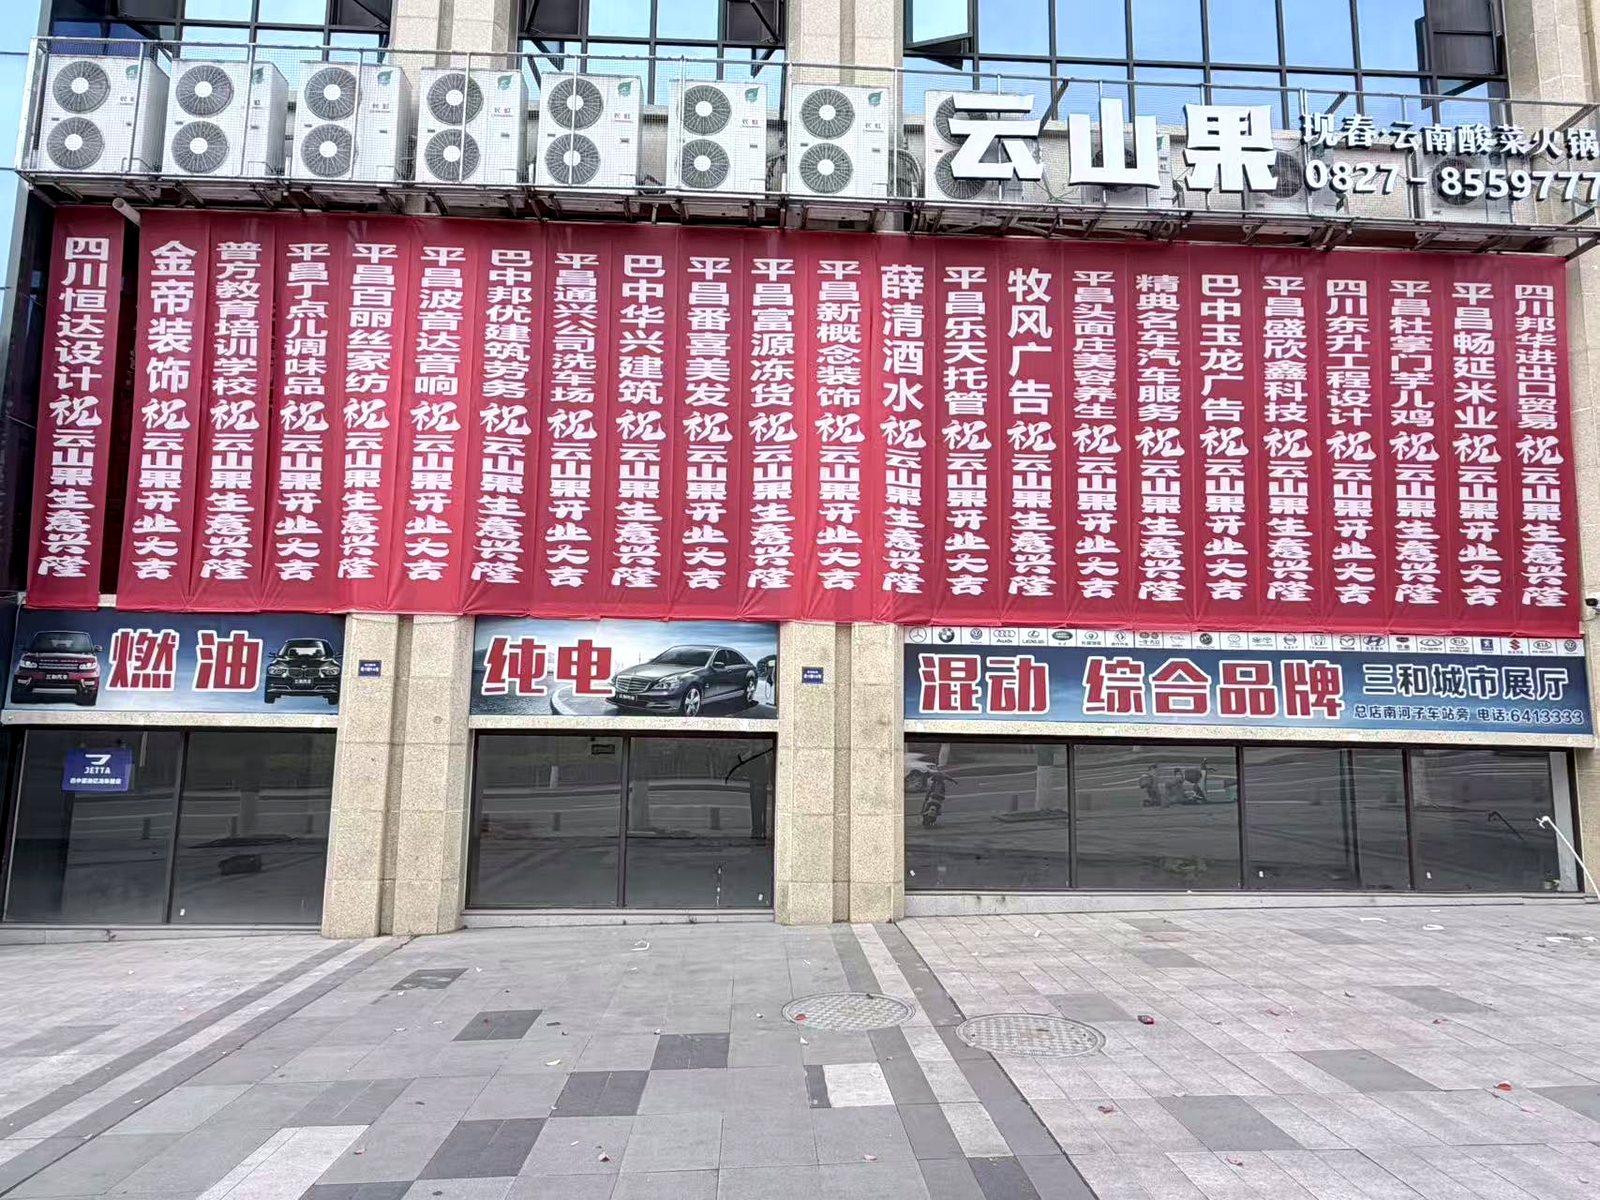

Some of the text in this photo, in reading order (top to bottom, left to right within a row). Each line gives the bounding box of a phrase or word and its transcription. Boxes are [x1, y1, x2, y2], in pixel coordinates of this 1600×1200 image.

[947, 93, 1279, 191] 云山果
[106, 627, 263, 693] 燃油
[482, 635, 616, 697] 纯电
[918, 652, 1051, 715] 混动
[1082, 655, 1346, 720] 综合品牌
[1362, 663, 1570, 701] 三和城市展厅
[1353, 704, 1471, 722] 总店南河子车站旁
[84, 766, 111, 774] JETTA
